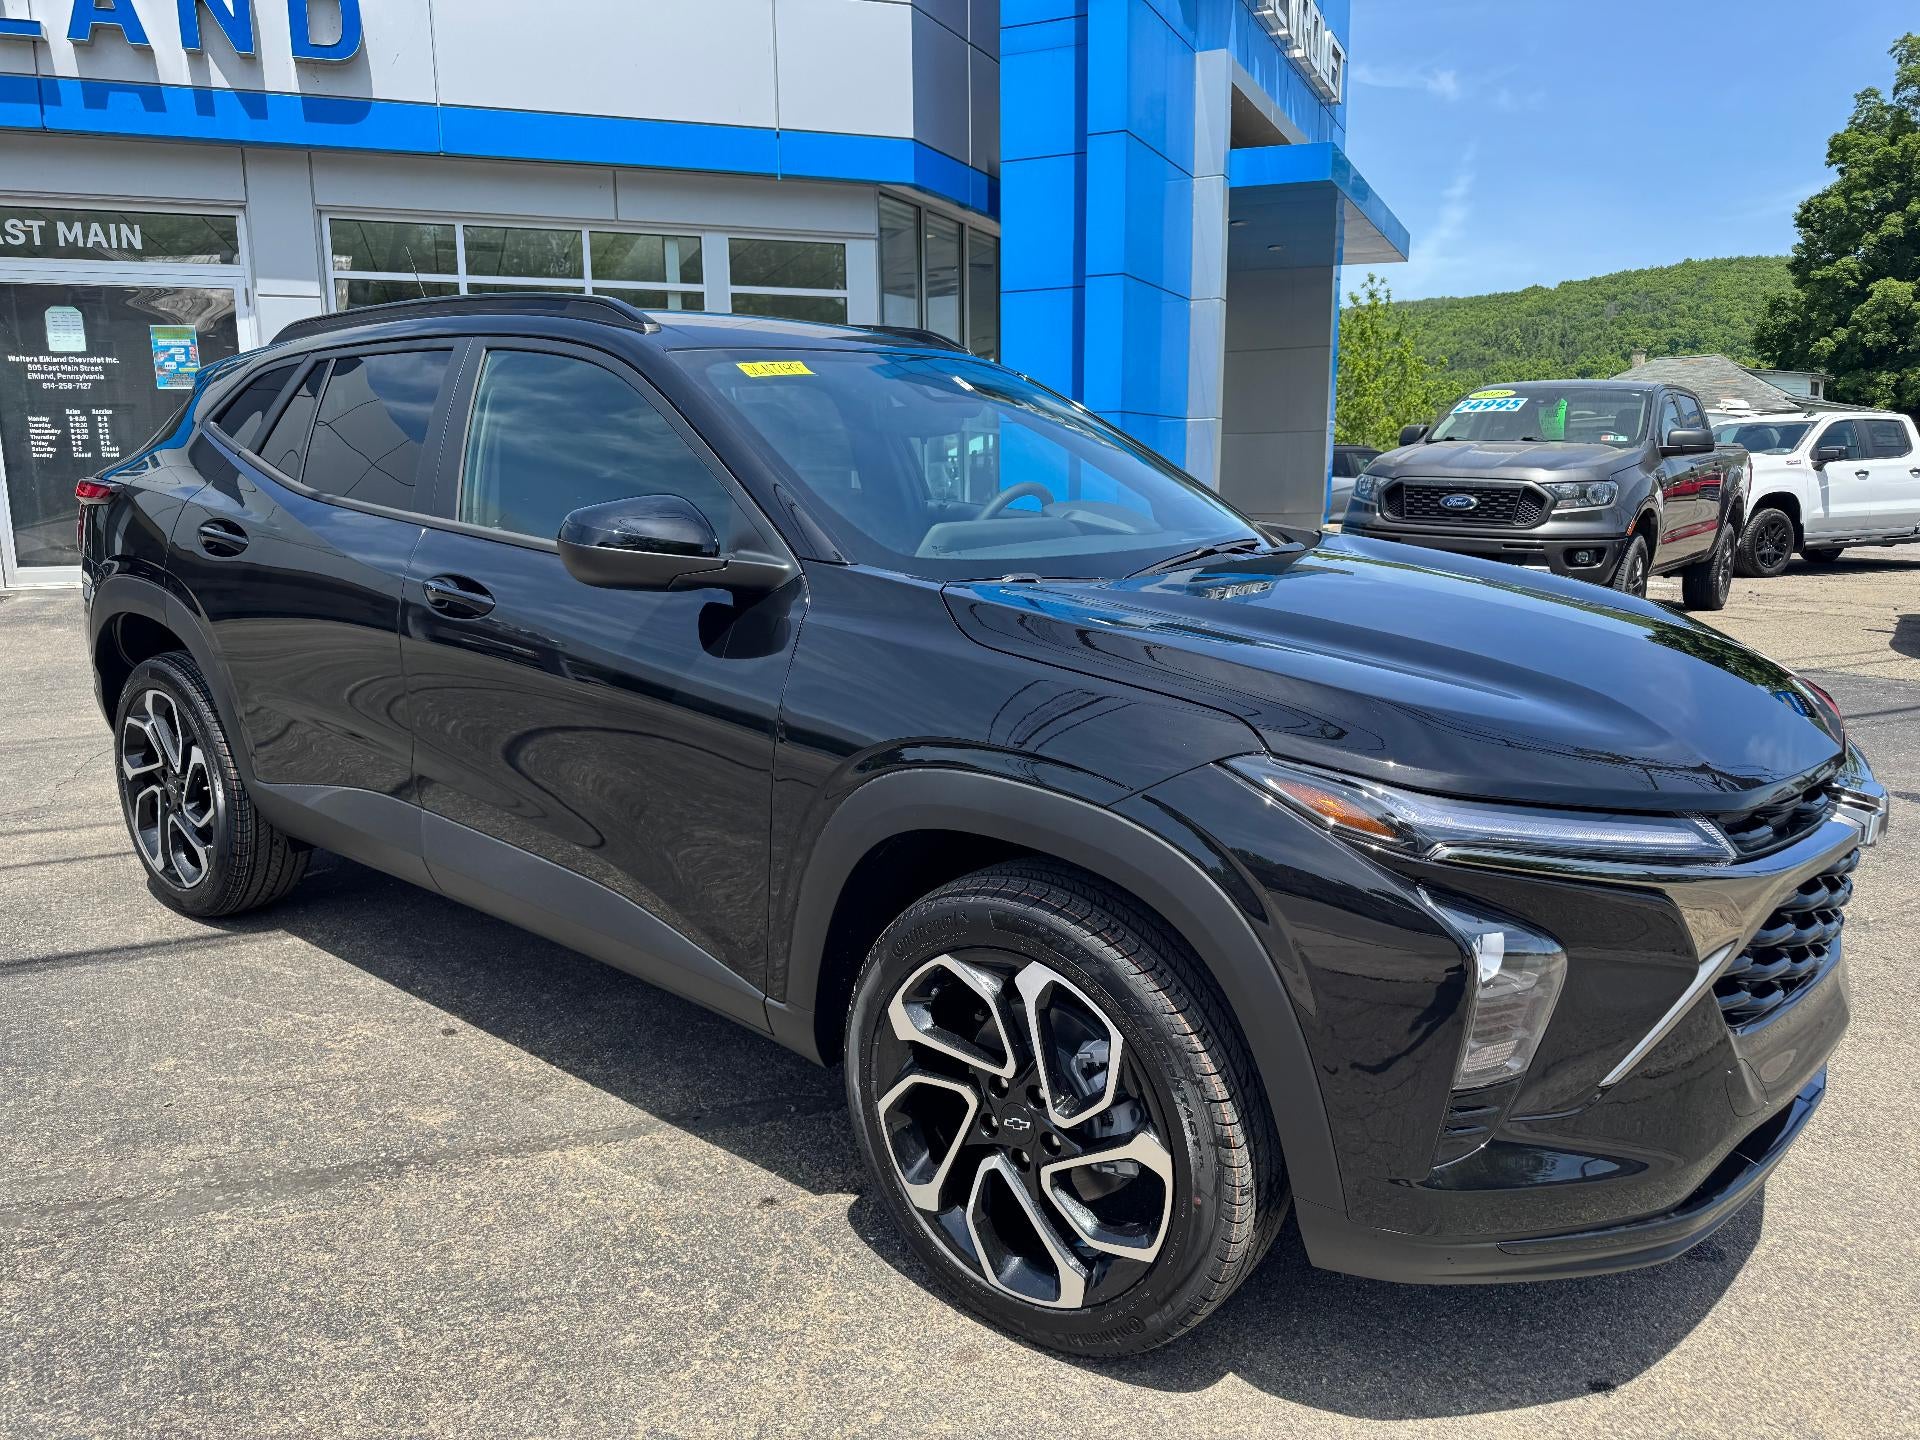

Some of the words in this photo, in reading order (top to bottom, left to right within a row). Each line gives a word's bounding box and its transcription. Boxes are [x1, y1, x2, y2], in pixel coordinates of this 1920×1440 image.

[56, 221, 143, 250] MAIN
[7, 355, 38, 363] Walters
[39, 355, 68, 363] Elkland
[68, 355, 105, 364] Chevrolet
[105, 356, 120, 364] Inc.
[43, 364, 60, 372] East
[61, 364, 79, 372] Main
[79, 364, 103, 372] Street
[27, 373, 57, 381] Elkland,
[57, 373, 105, 382] Pennsylvania
[42, 382, 92, 390] 814-258-7127
[1453, 399, 1525, 412] 24995
[27, 415, 50, 423] Monday
